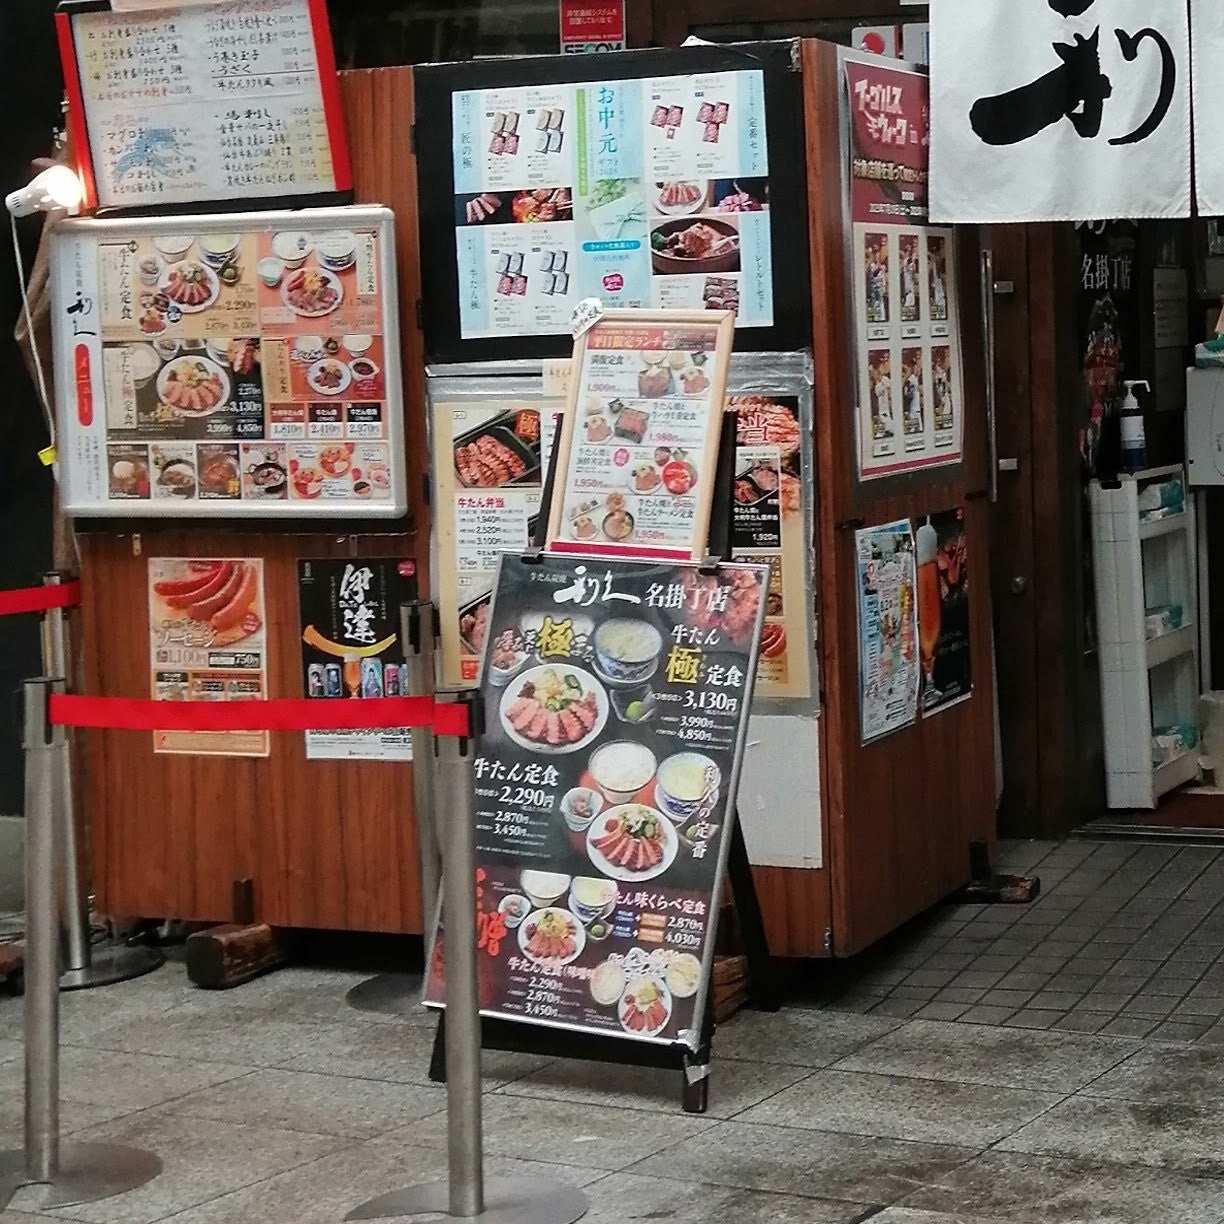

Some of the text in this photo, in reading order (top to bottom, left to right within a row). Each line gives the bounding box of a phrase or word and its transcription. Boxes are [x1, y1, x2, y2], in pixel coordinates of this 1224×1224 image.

[597, 86, 618, 155] お中元
[458, 497, 504, 508] 牛たん弁当
[645, 581, 731, 612] 名掛丁店
[671, 623, 721, 646] 牛たん
[682, 689, 738, 711] 3,130円
[680, 715, 715, 728] 3,990円
[677, 728, 712, 741] 4,850円
[474, 757, 560, 787] 牛たん定食
[498, 785, 555, 808] 2,290円
[494, 810, 530, 825] 2,870円
[493, 823, 528, 837] 3,450円
[667, 916, 704, 931] 2,870円
[665, 931, 702, 946] 4,030円
[528, 976, 563, 991] 2,290円
[526, 989, 561, 1005] 2,870円
[524, 1002, 559, 1018] 3,450円
